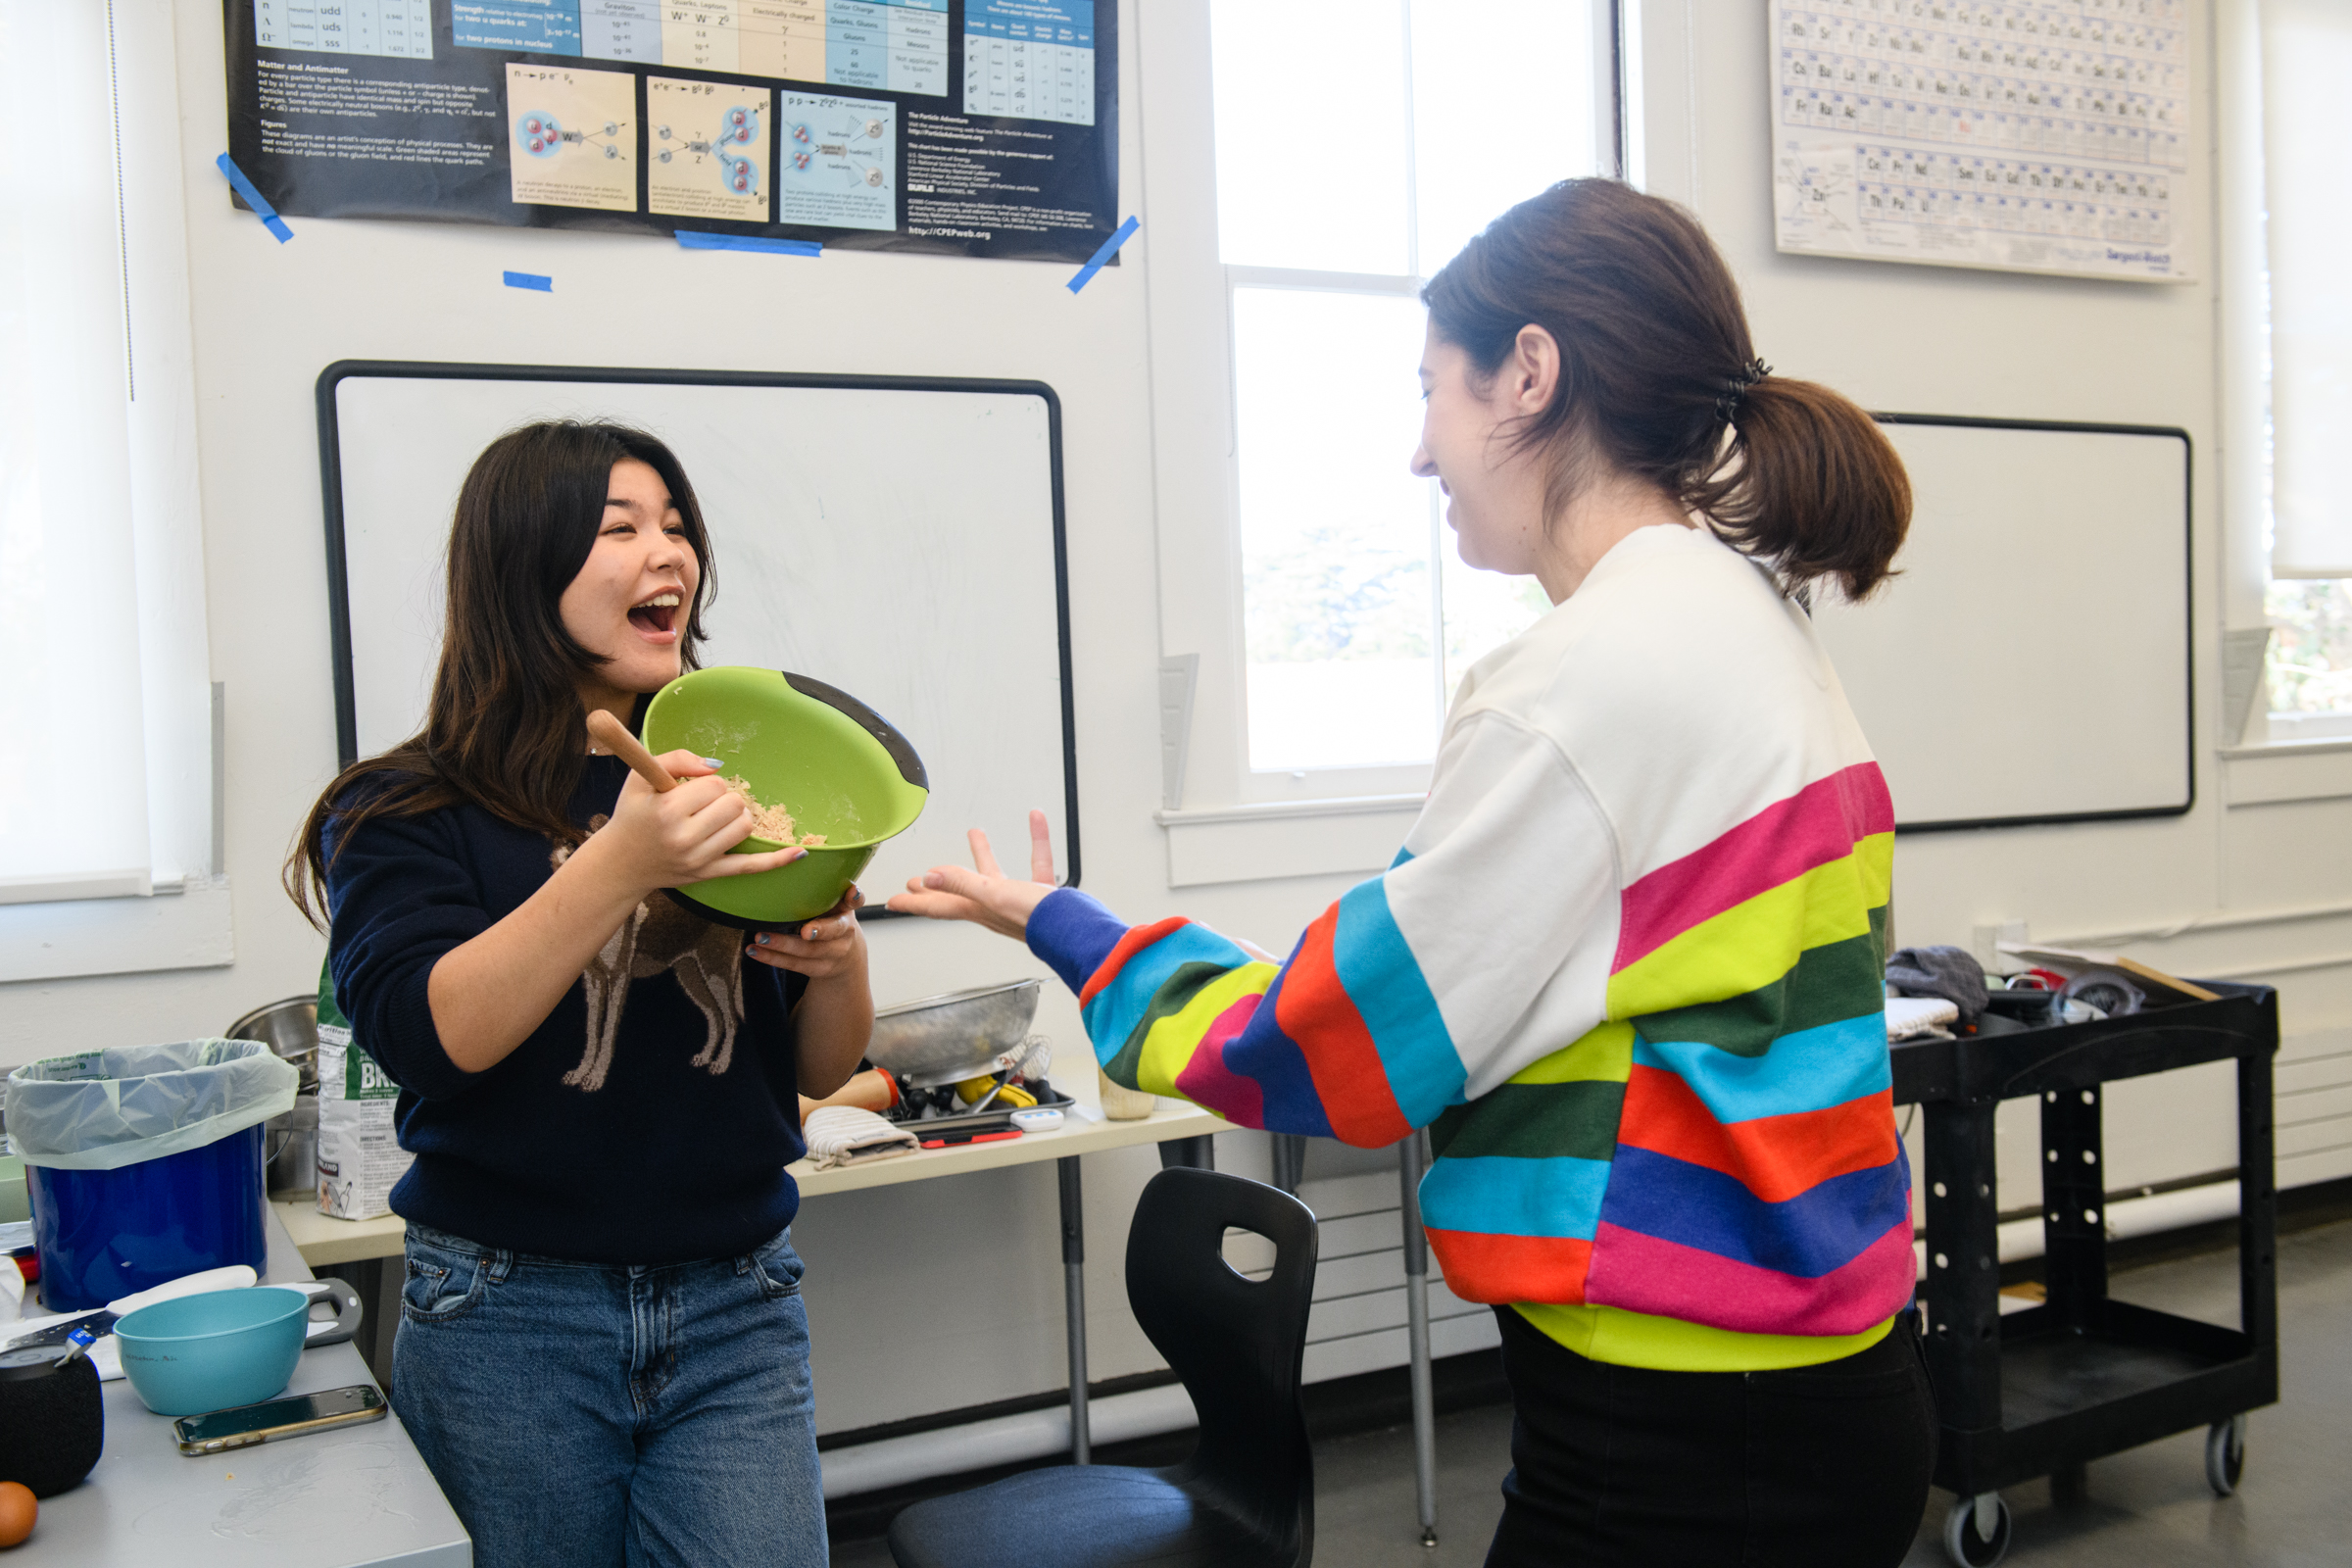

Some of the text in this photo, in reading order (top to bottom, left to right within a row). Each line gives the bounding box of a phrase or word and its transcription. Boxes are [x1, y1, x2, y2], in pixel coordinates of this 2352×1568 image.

[320, 7, 341, 15] udd
[454, 4, 484, 14] Strength
[490, 17, 515, 26] quarks
[322, 23, 341, 32] uds
[524, 40, 553, 48] nucleus
[257, 59, 285, 69] Matter
[305, 64, 349, 74] Antimatter
[365, 80, 412, 89] corresponding
[259, 87, 284, 95] Particle
[261, 119, 287, 129] Figures
[282, 132, 313, 140] diagrams
[465, 142, 481, 150] They
[337, 144, 375, 153] meaningful
[908, 226, 991, 241] http://CPEPweb.org
